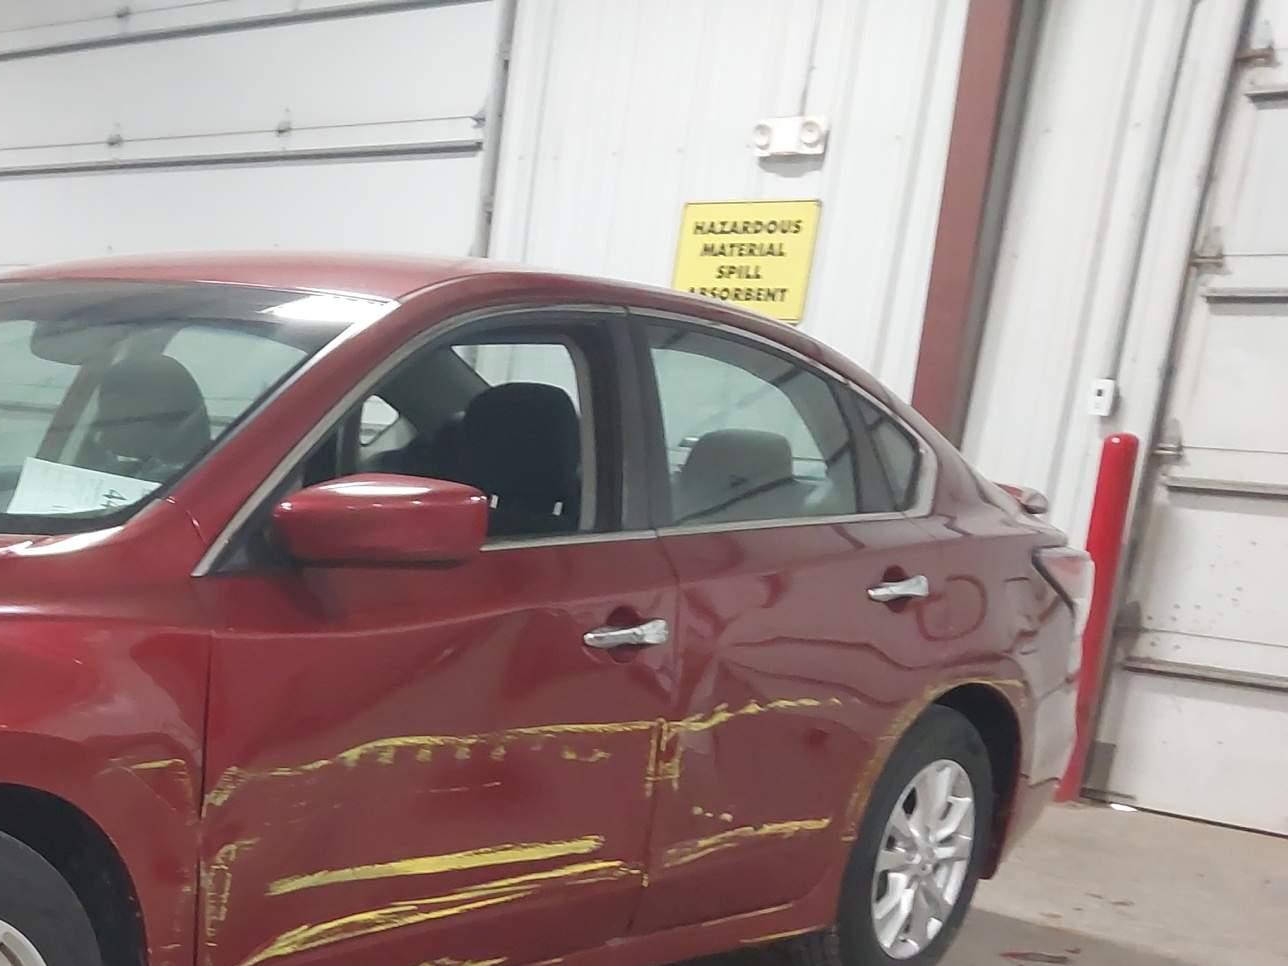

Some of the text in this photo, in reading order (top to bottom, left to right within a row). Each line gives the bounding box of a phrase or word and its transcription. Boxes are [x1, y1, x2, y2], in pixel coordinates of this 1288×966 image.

[693, 220, 802, 235] HAZARDOUS
[700, 242, 785, 256] MATERIAL
[716, 265, 762, 279] SPILL
